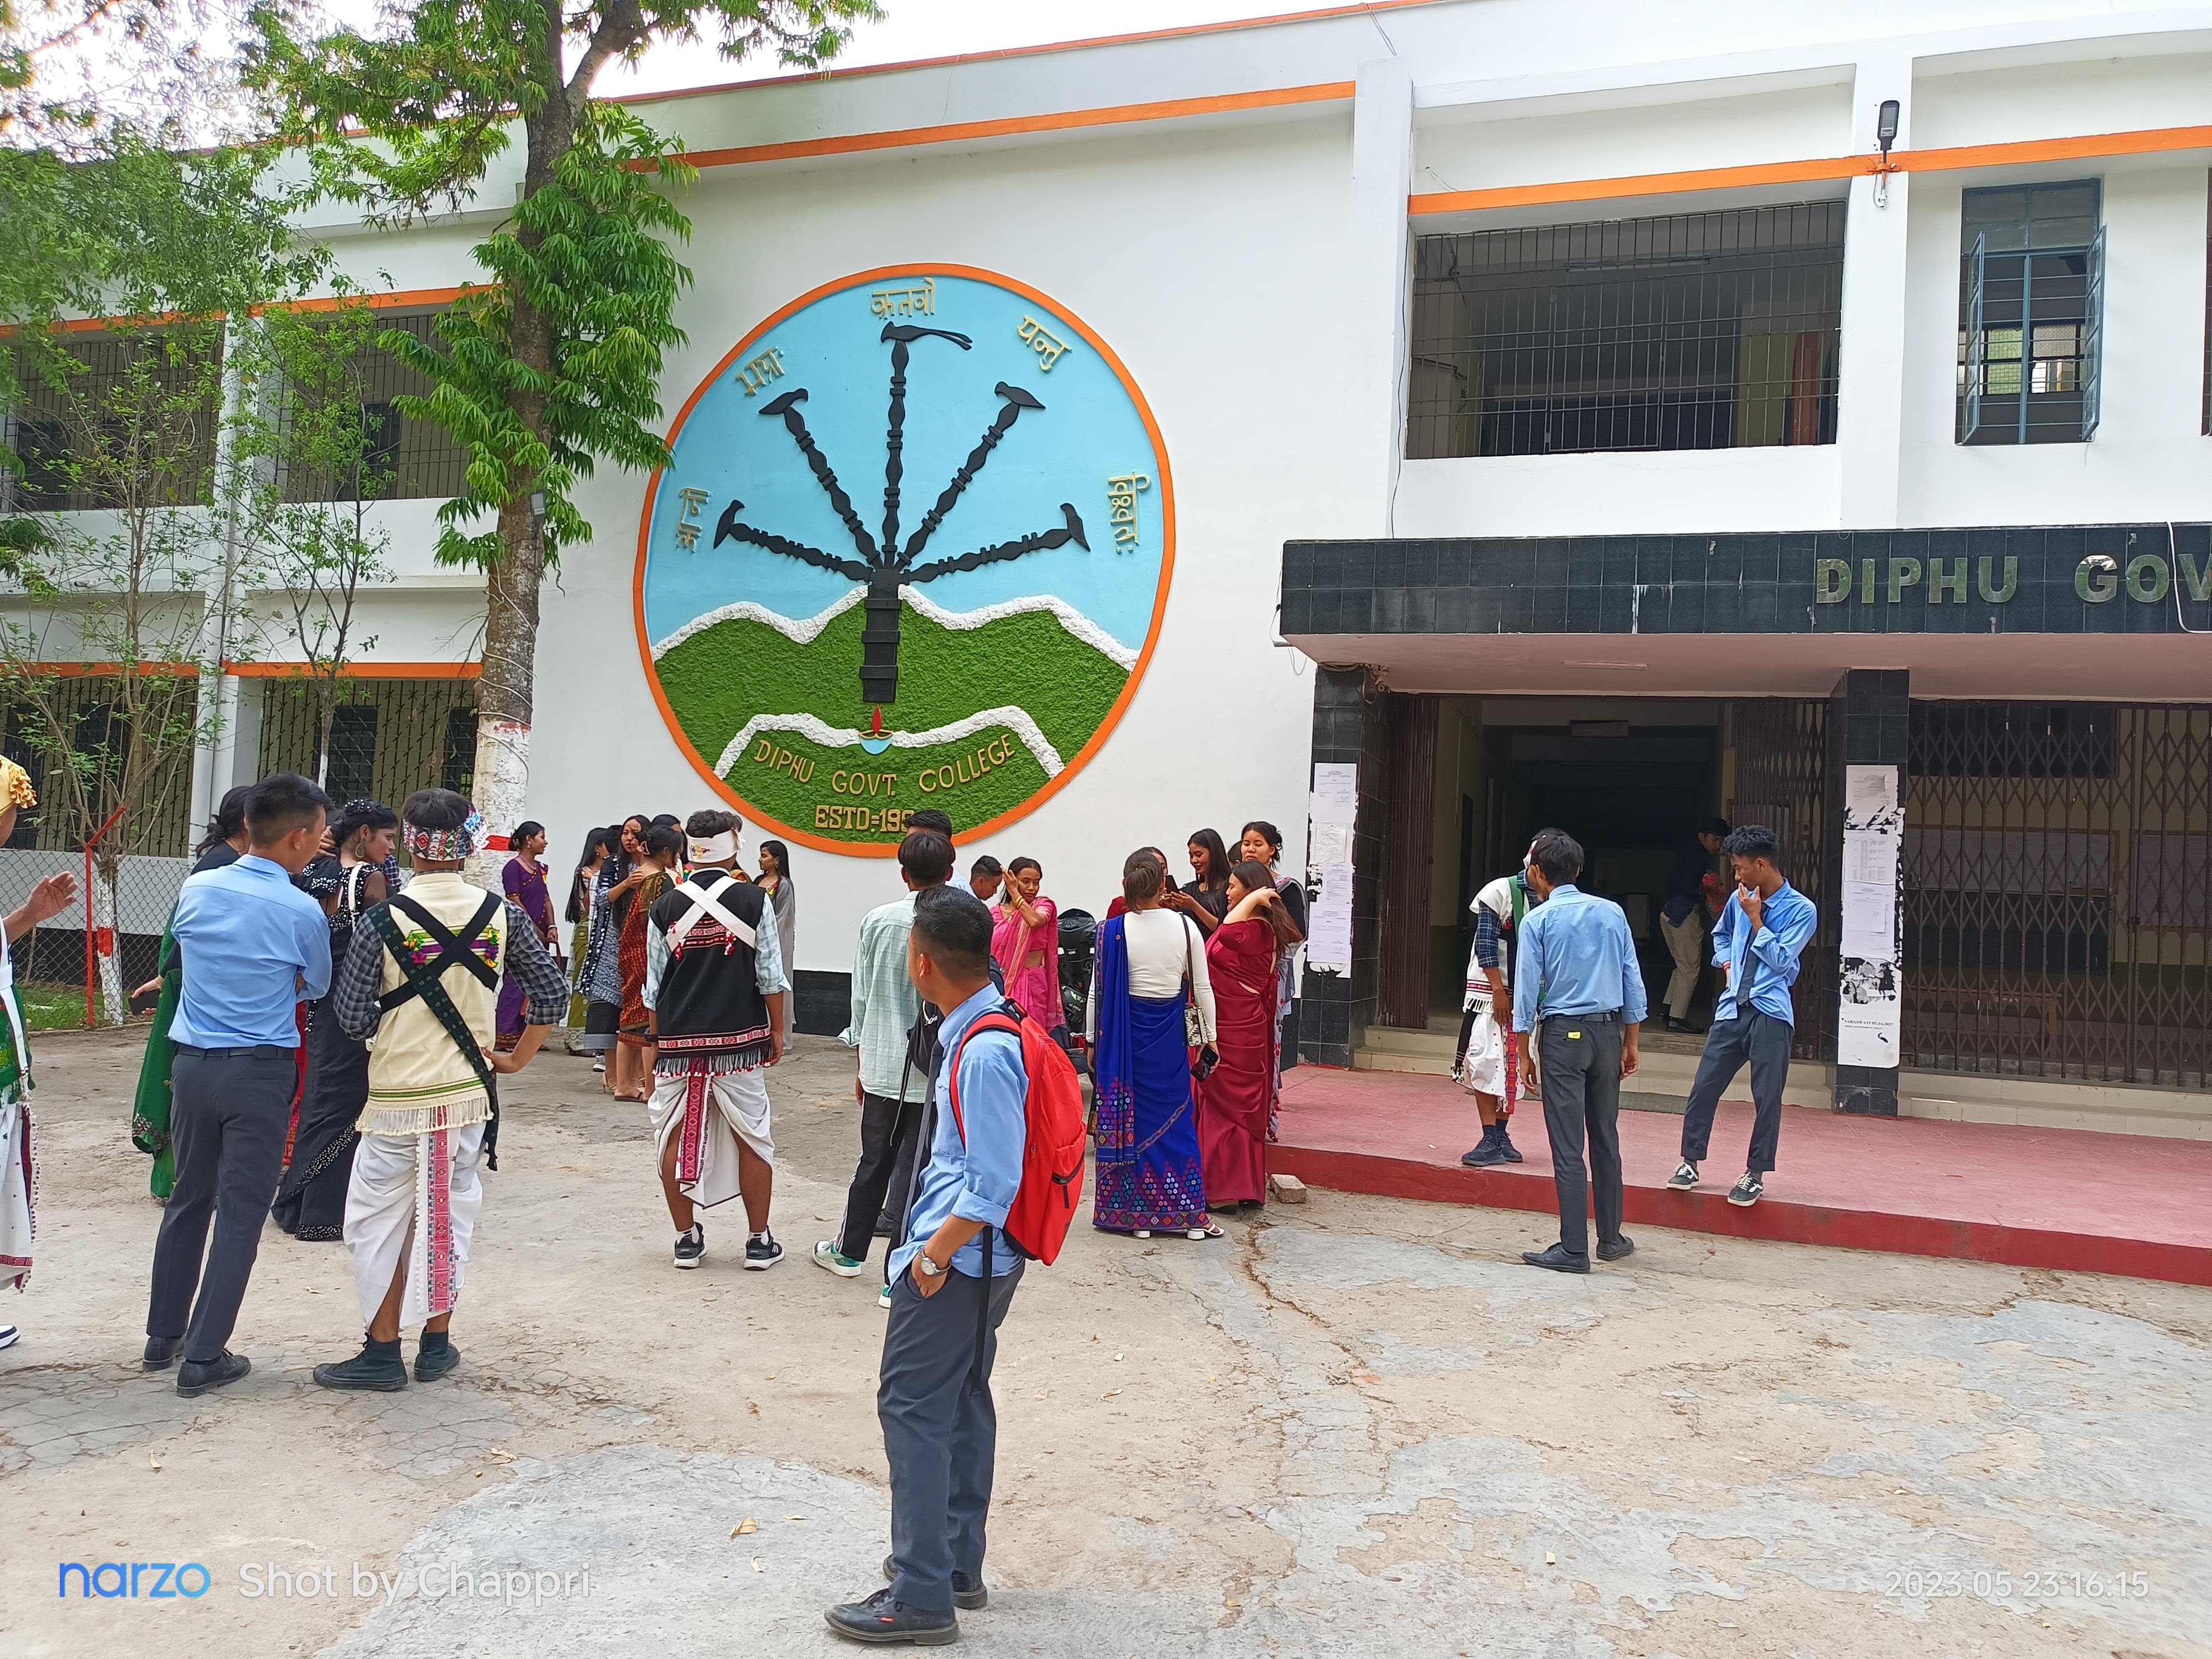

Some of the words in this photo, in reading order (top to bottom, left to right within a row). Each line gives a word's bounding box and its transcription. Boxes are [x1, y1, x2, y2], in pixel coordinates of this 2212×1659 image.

[1816, 556, 2018, 604] DIPHU
[753, 739, 816, 784] DIPHU
[832, 769, 896, 797] GOVT.
[918, 734, 1015, 793] COLLEGE
